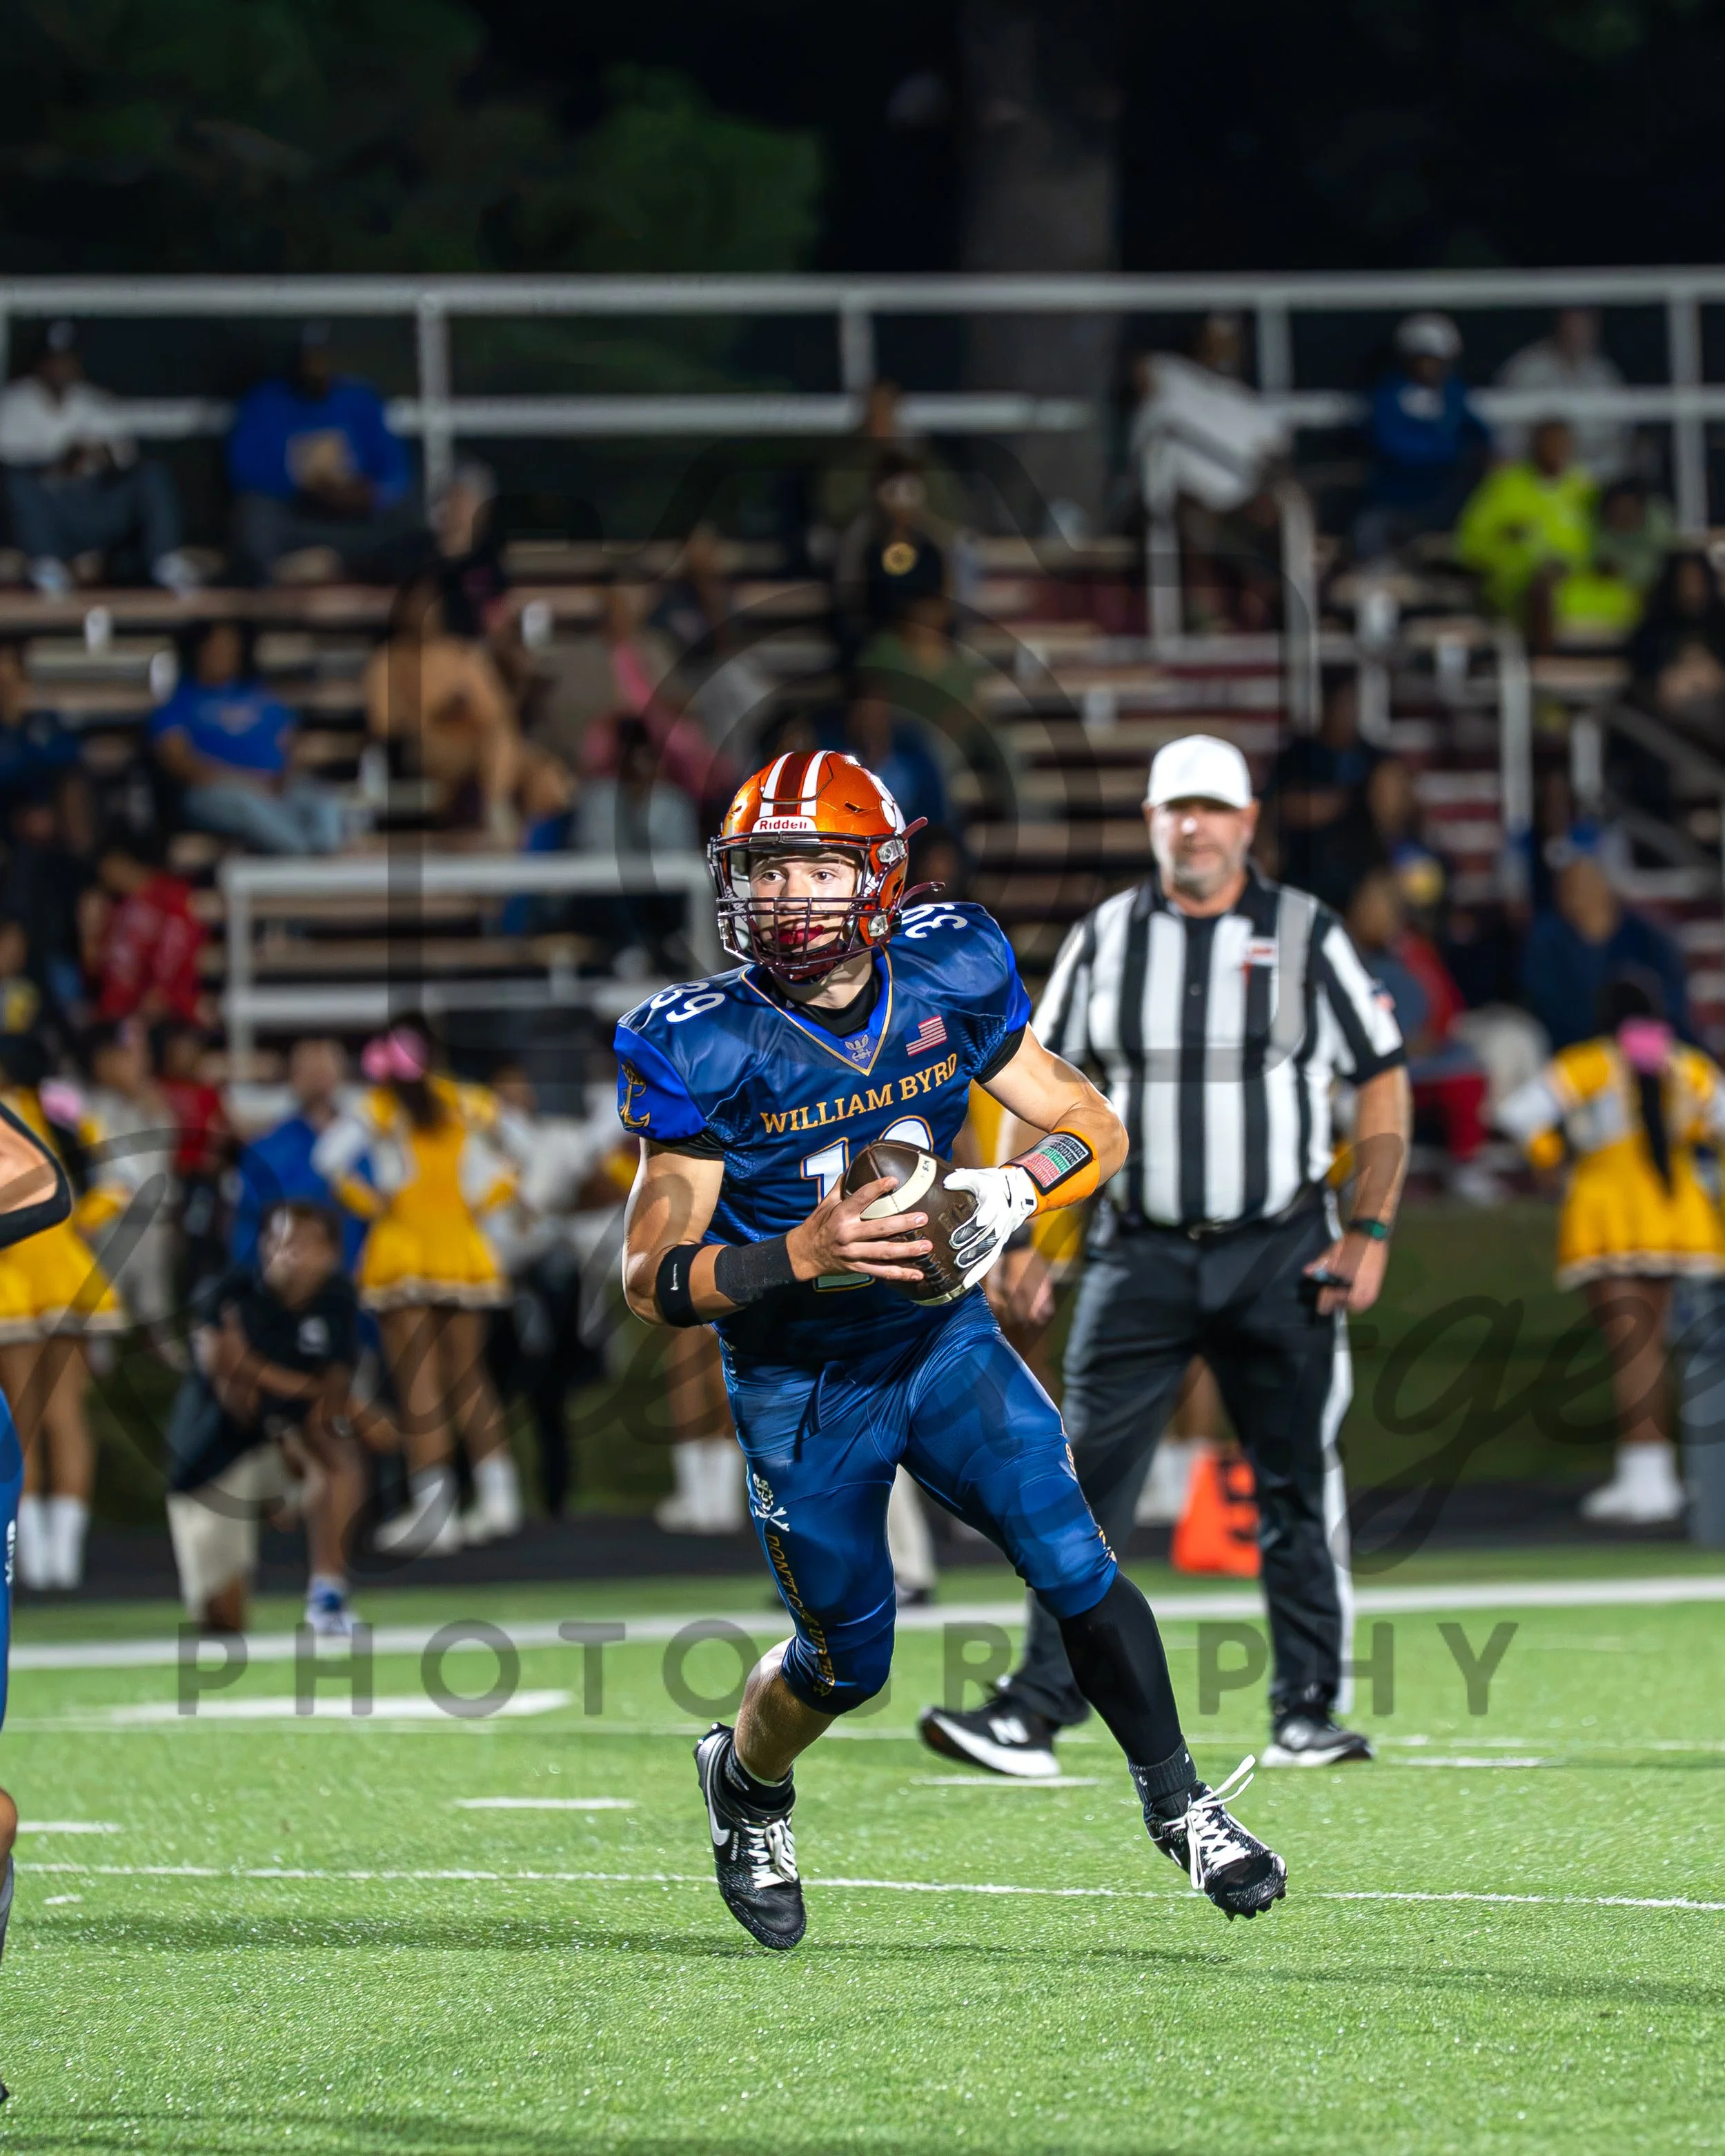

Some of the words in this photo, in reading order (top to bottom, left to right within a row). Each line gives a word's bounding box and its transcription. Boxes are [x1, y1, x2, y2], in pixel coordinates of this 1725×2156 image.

[760, 820, 807, 830] Riddell
[650, 982, 726, 1022] 39
[760, 1082, 894, 1134] WILLIAM
[898, 1053, 958, 1101] BYRD
